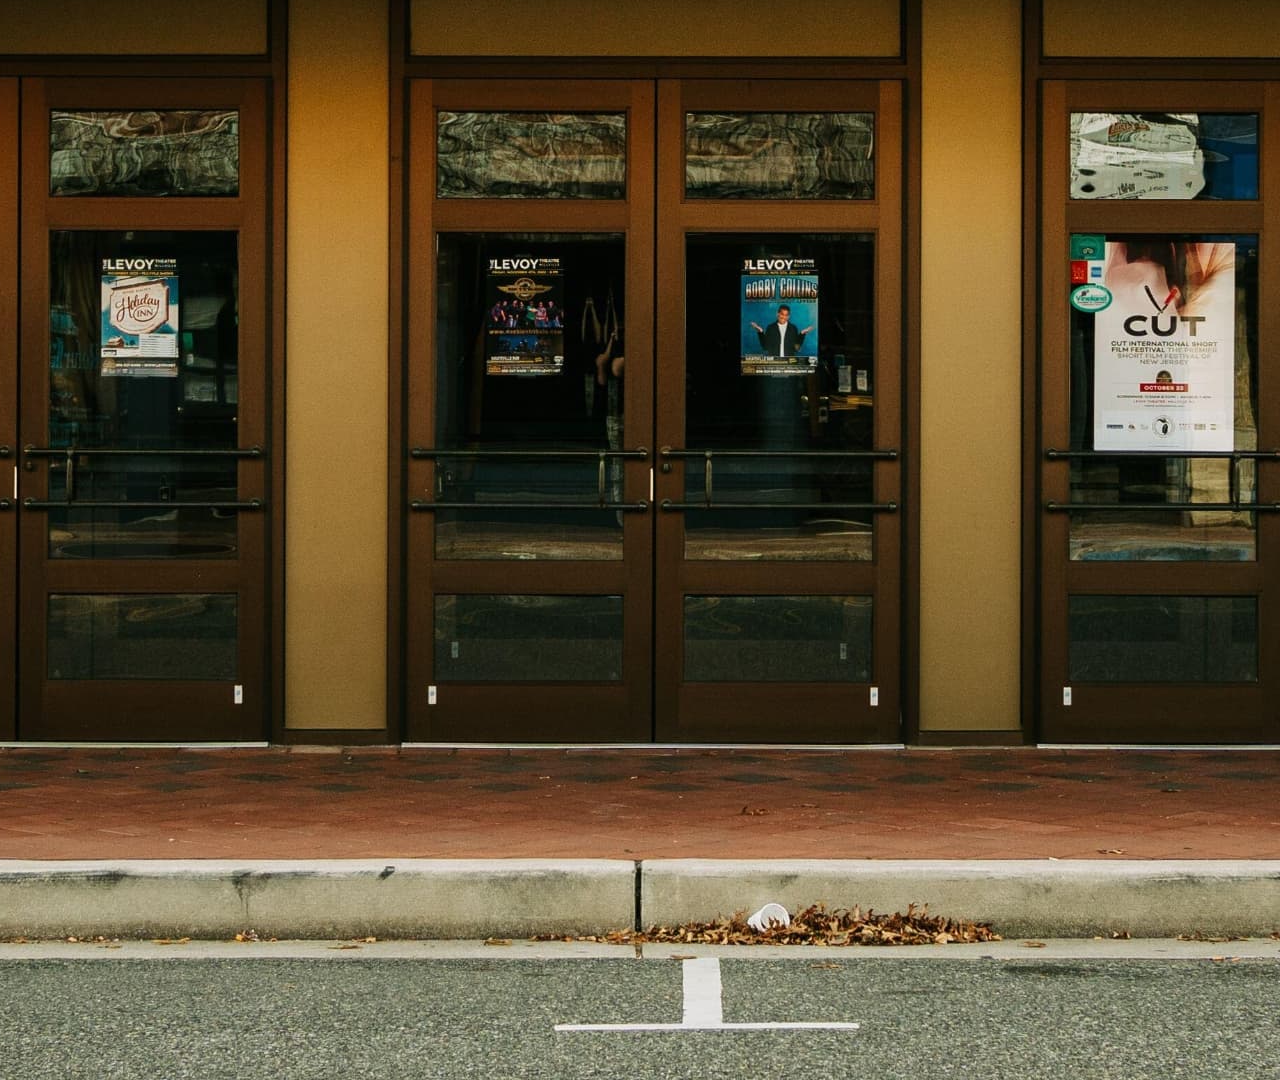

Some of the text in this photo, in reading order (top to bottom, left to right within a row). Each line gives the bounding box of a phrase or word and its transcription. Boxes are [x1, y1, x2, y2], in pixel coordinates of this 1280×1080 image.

[108, 259, 154, 270] LEVOY
[495, 259, 538, 270] LEVOY
[749, 259, 793, 270] LEVOY
[746, 277, 817, 297] BOBBY COLLINS
[115, 293, 160, 322] Holiday
[1123, 315, 1206, 337] CUT
